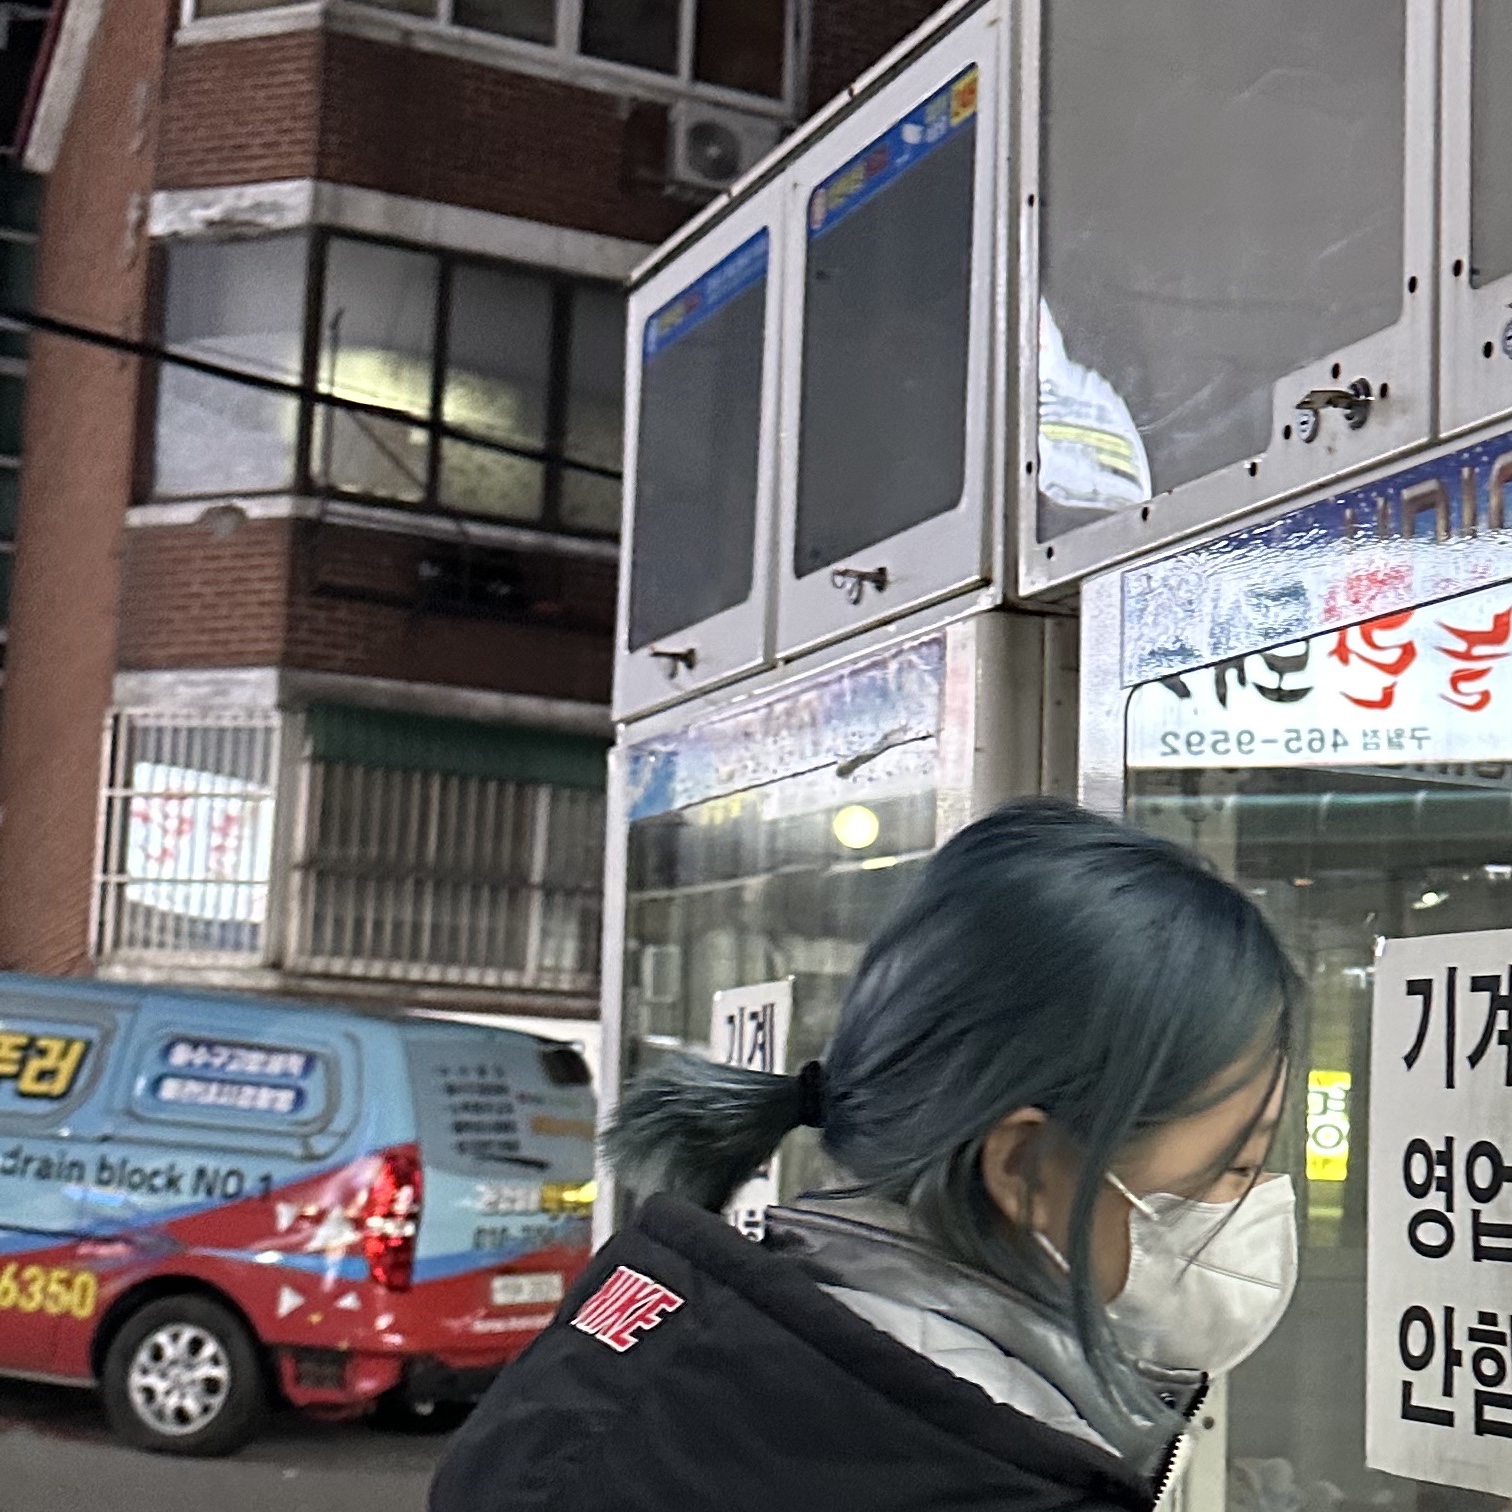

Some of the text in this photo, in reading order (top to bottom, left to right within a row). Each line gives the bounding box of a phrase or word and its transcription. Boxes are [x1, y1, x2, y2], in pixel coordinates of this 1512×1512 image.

[727, 1003, 776, 1073] 기계
[1, 1146, 86, 1182] drain
[95, 1154, 184, 1195] block
[569, 1265, 686, 1352] NIKE
